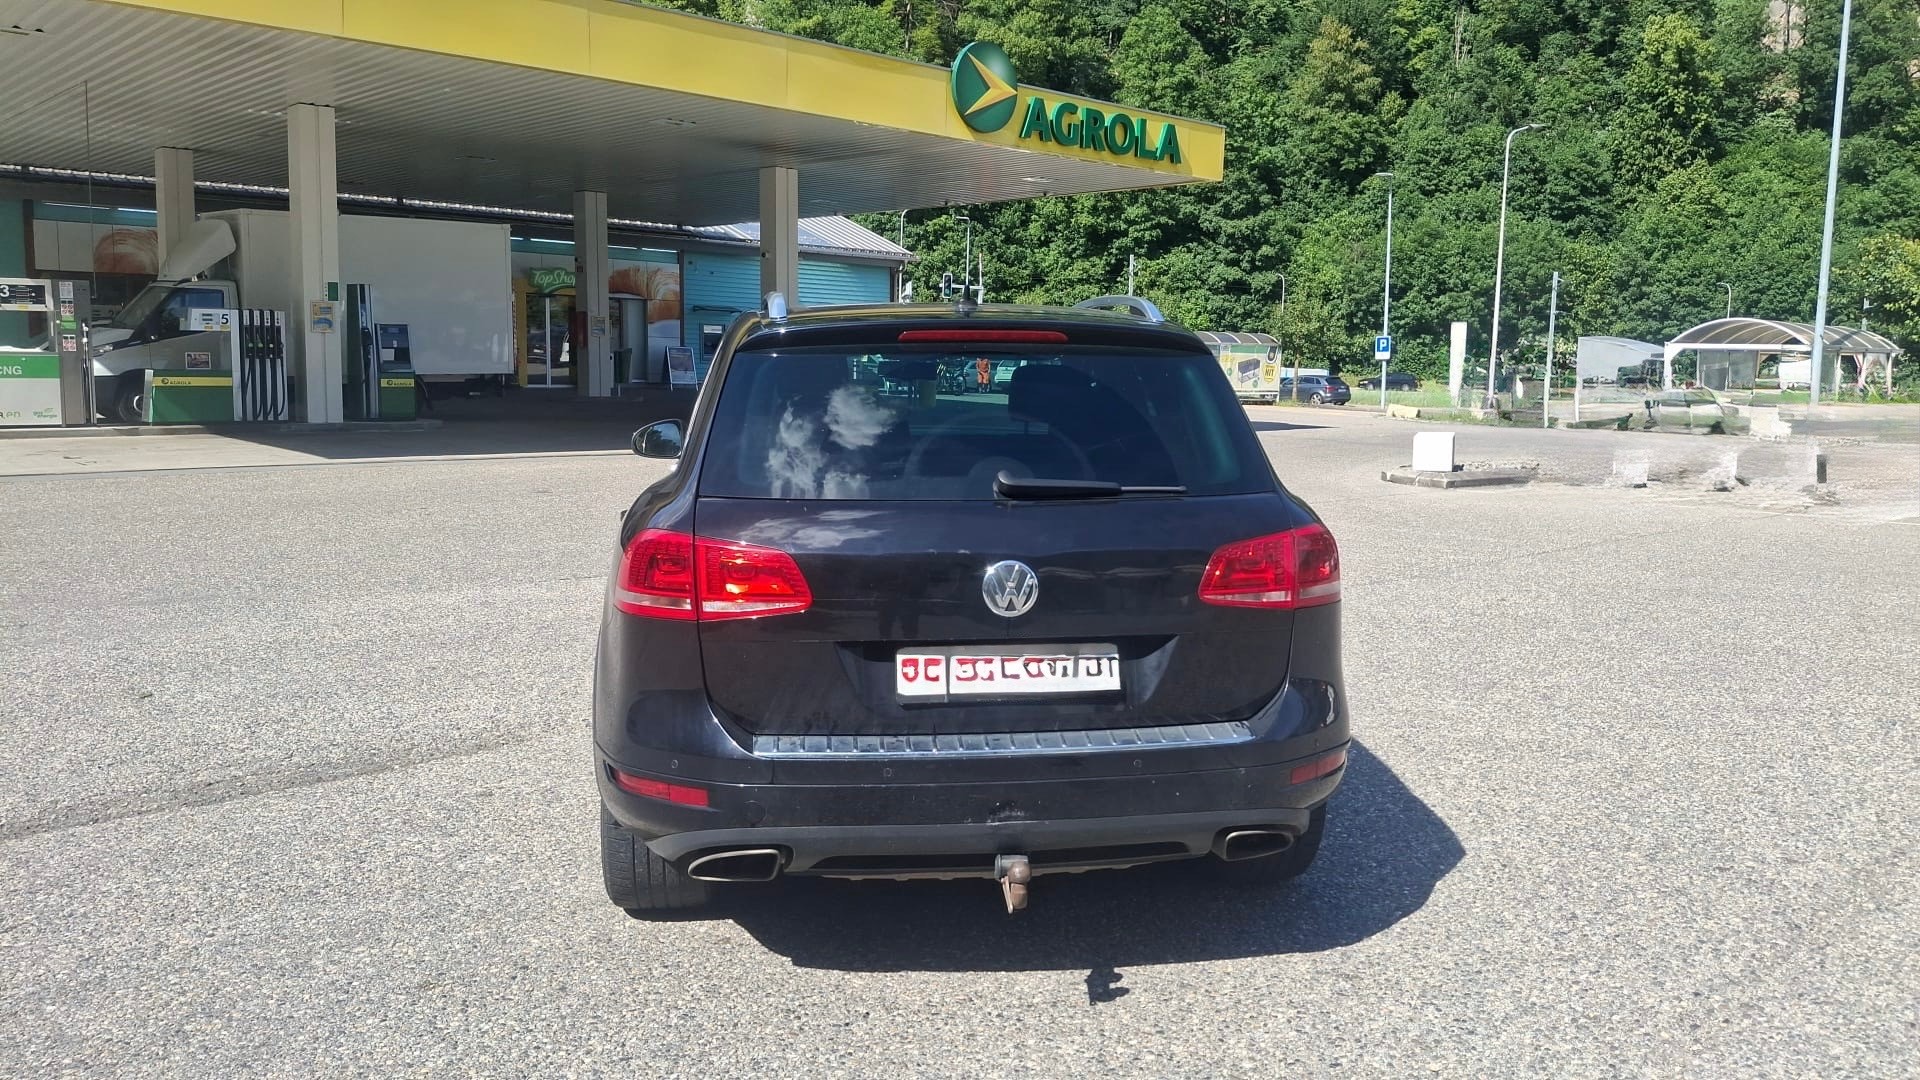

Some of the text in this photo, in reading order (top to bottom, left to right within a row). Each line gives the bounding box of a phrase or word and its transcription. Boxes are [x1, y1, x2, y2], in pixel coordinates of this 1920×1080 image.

[1019, 96, 1181, 164] AGROLA
[0, 285, 9, 297] 3
[221, 313, 229, 325] 5
[1379, 339, 1387, 351] P
[0, 365, 23, 375] NG
